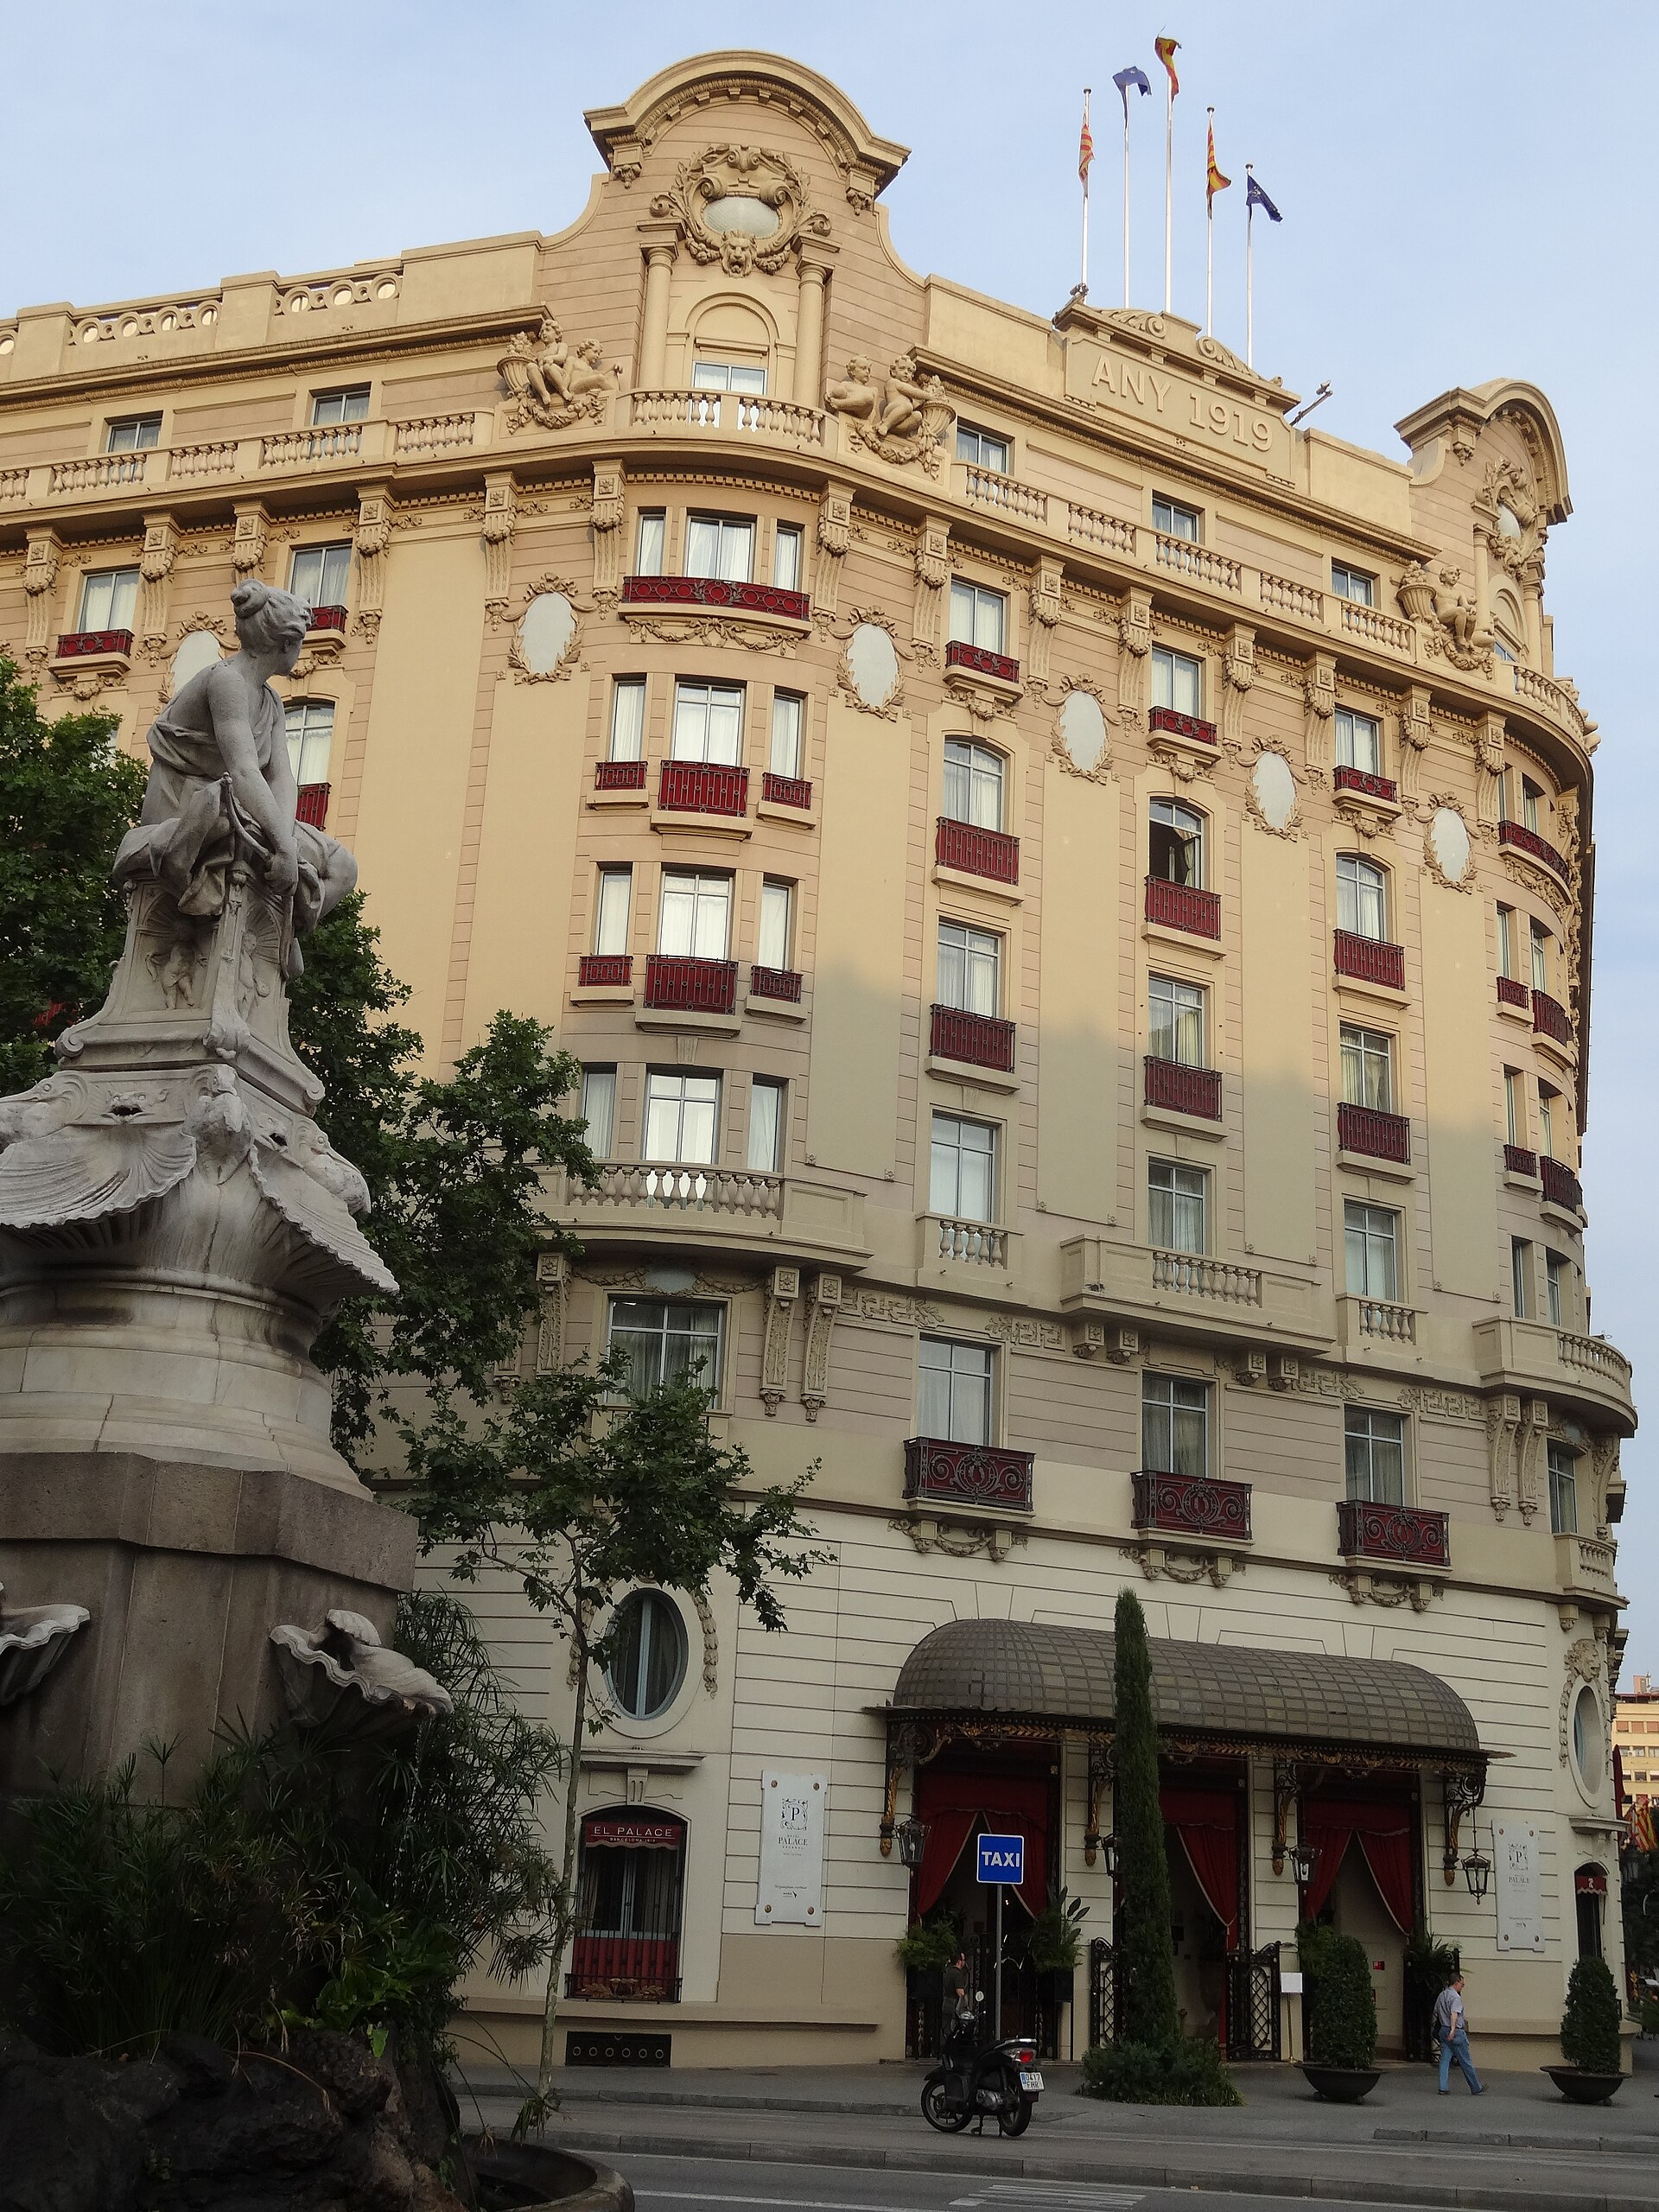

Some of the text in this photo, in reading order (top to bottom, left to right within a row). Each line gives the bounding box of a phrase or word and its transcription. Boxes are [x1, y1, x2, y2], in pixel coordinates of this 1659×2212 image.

[1091, 354, 1273, 452] ANY 1919
[594, 1826, 672, 1837] EL PALACE
[779, 1836, 809, 1846] PALACE
[981, 1851, 1020, 1867] TAXI
